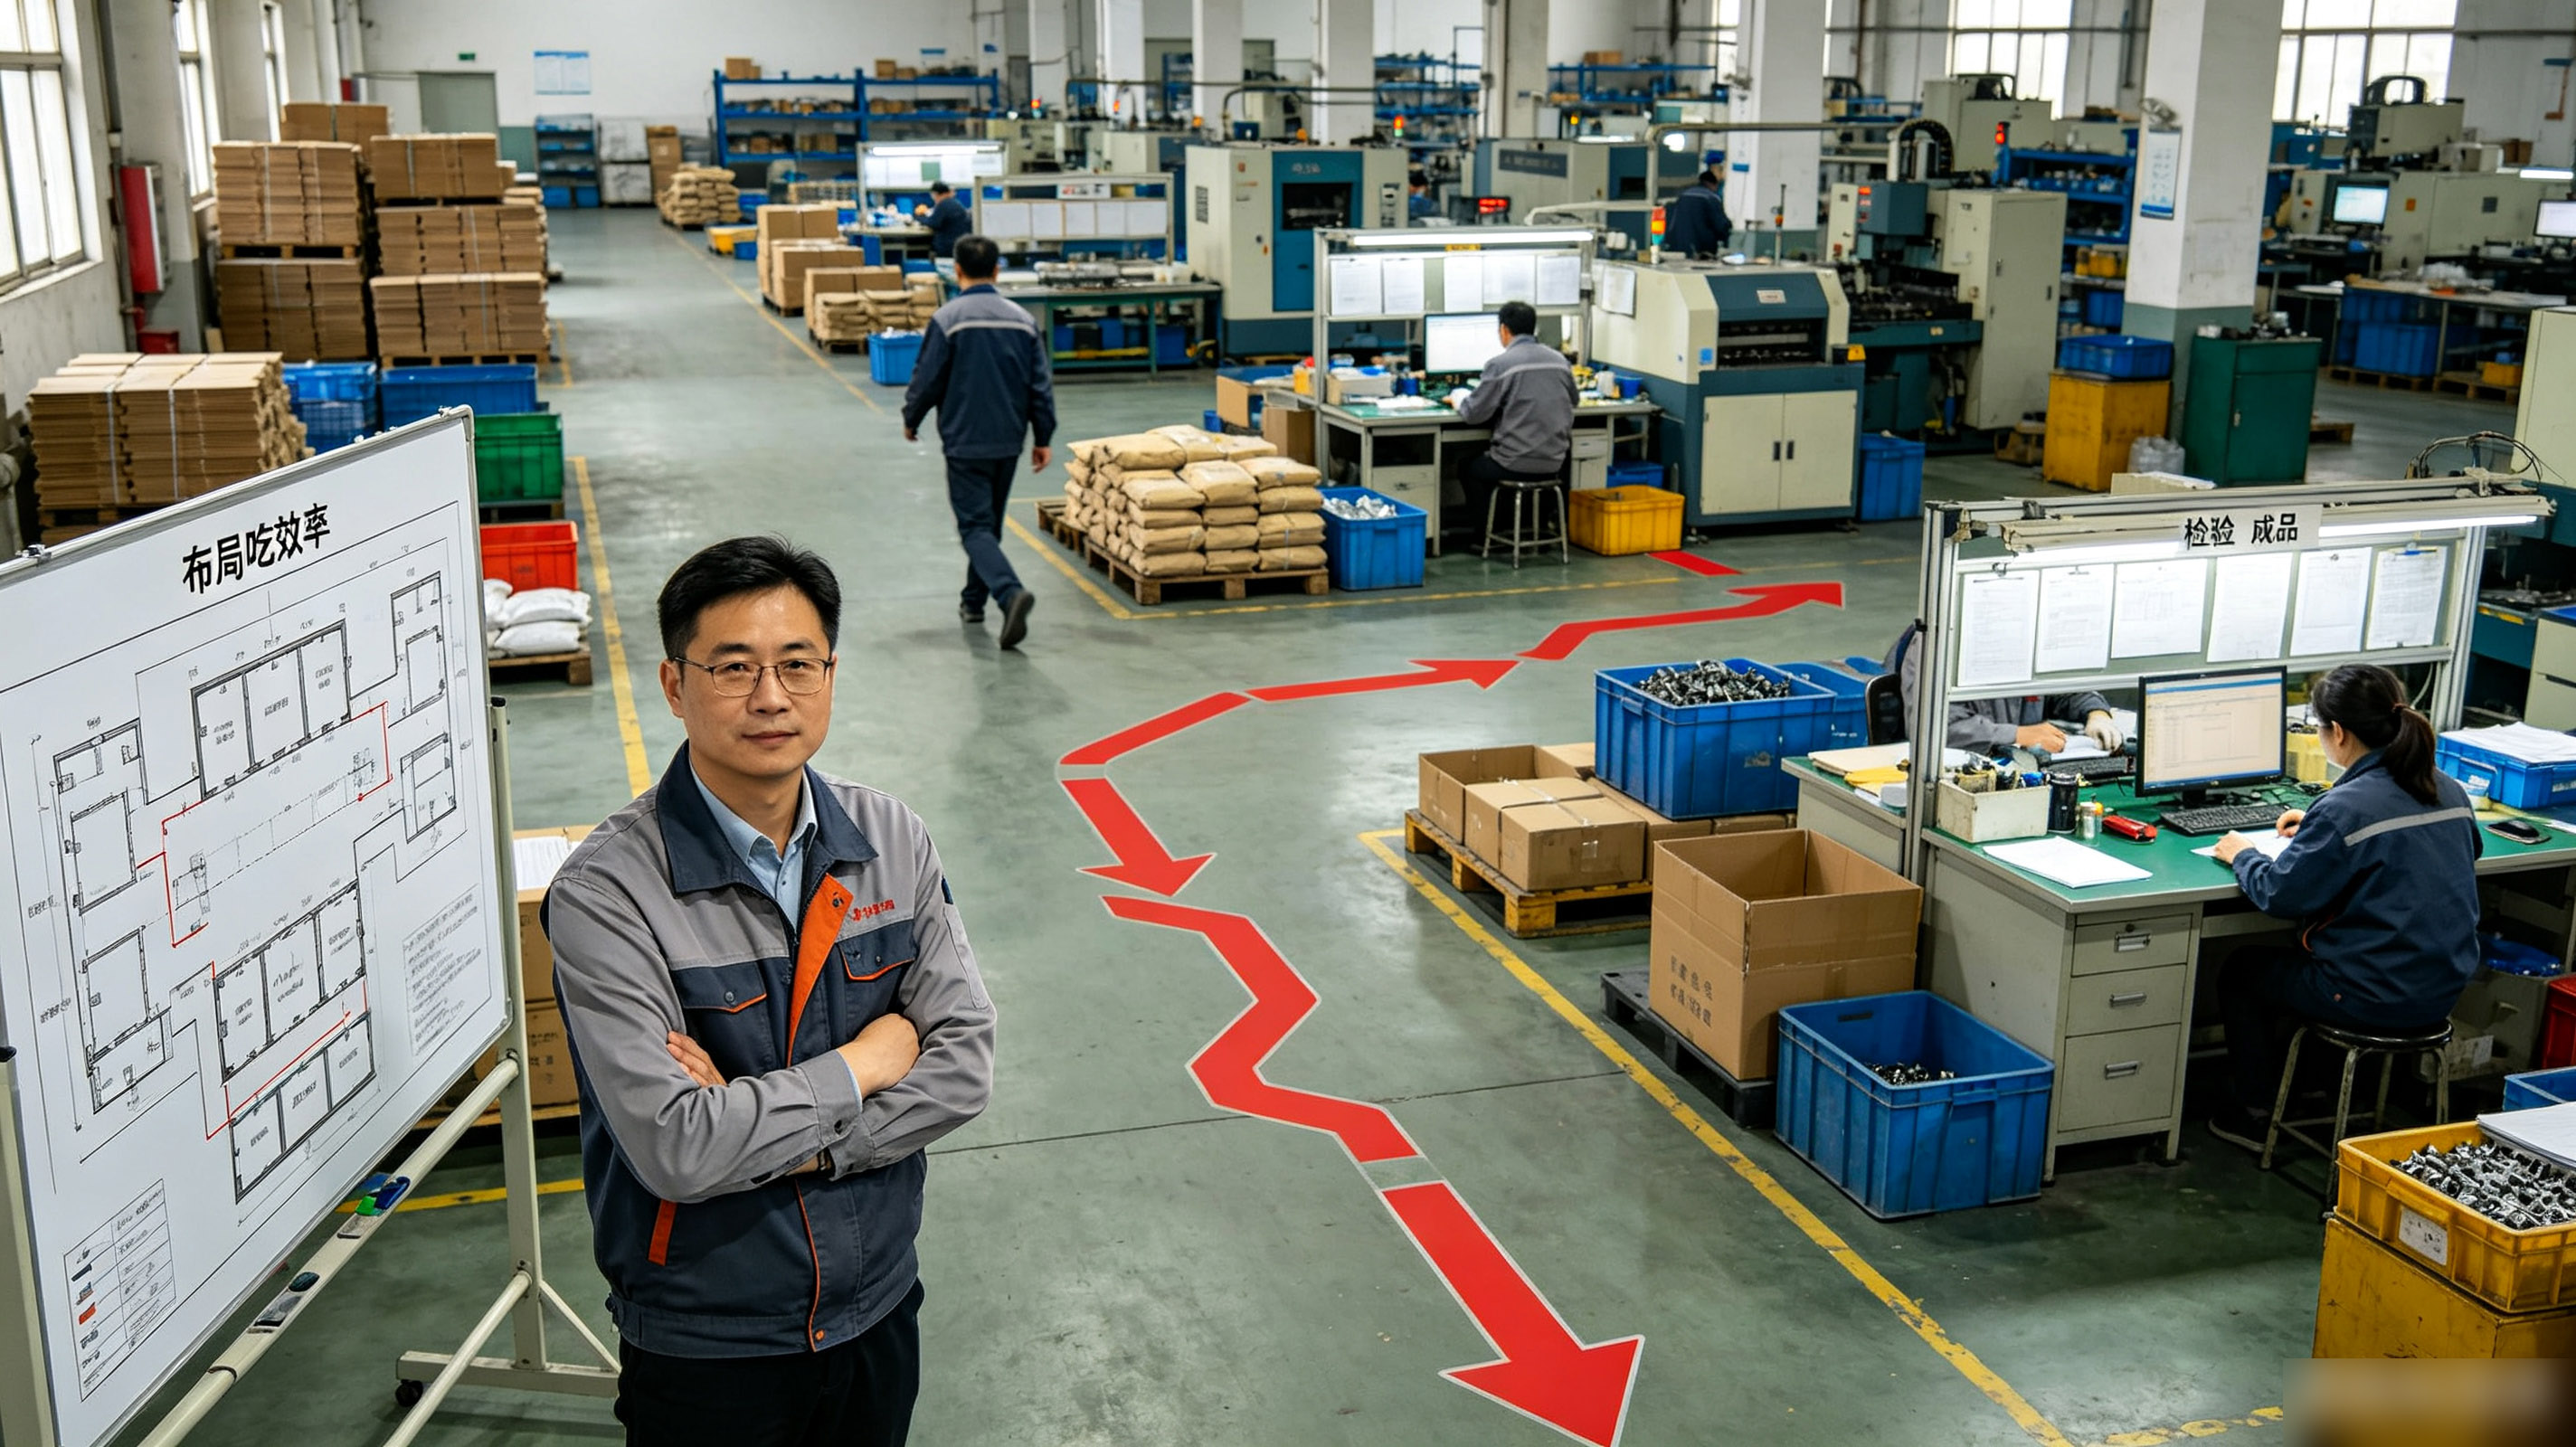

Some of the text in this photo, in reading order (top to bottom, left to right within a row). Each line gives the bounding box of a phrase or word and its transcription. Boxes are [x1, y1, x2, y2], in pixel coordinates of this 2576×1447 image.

[183, 503, 331, 594] 布局吃效率
[2184, 513, 2298, 550] 检验 成品
